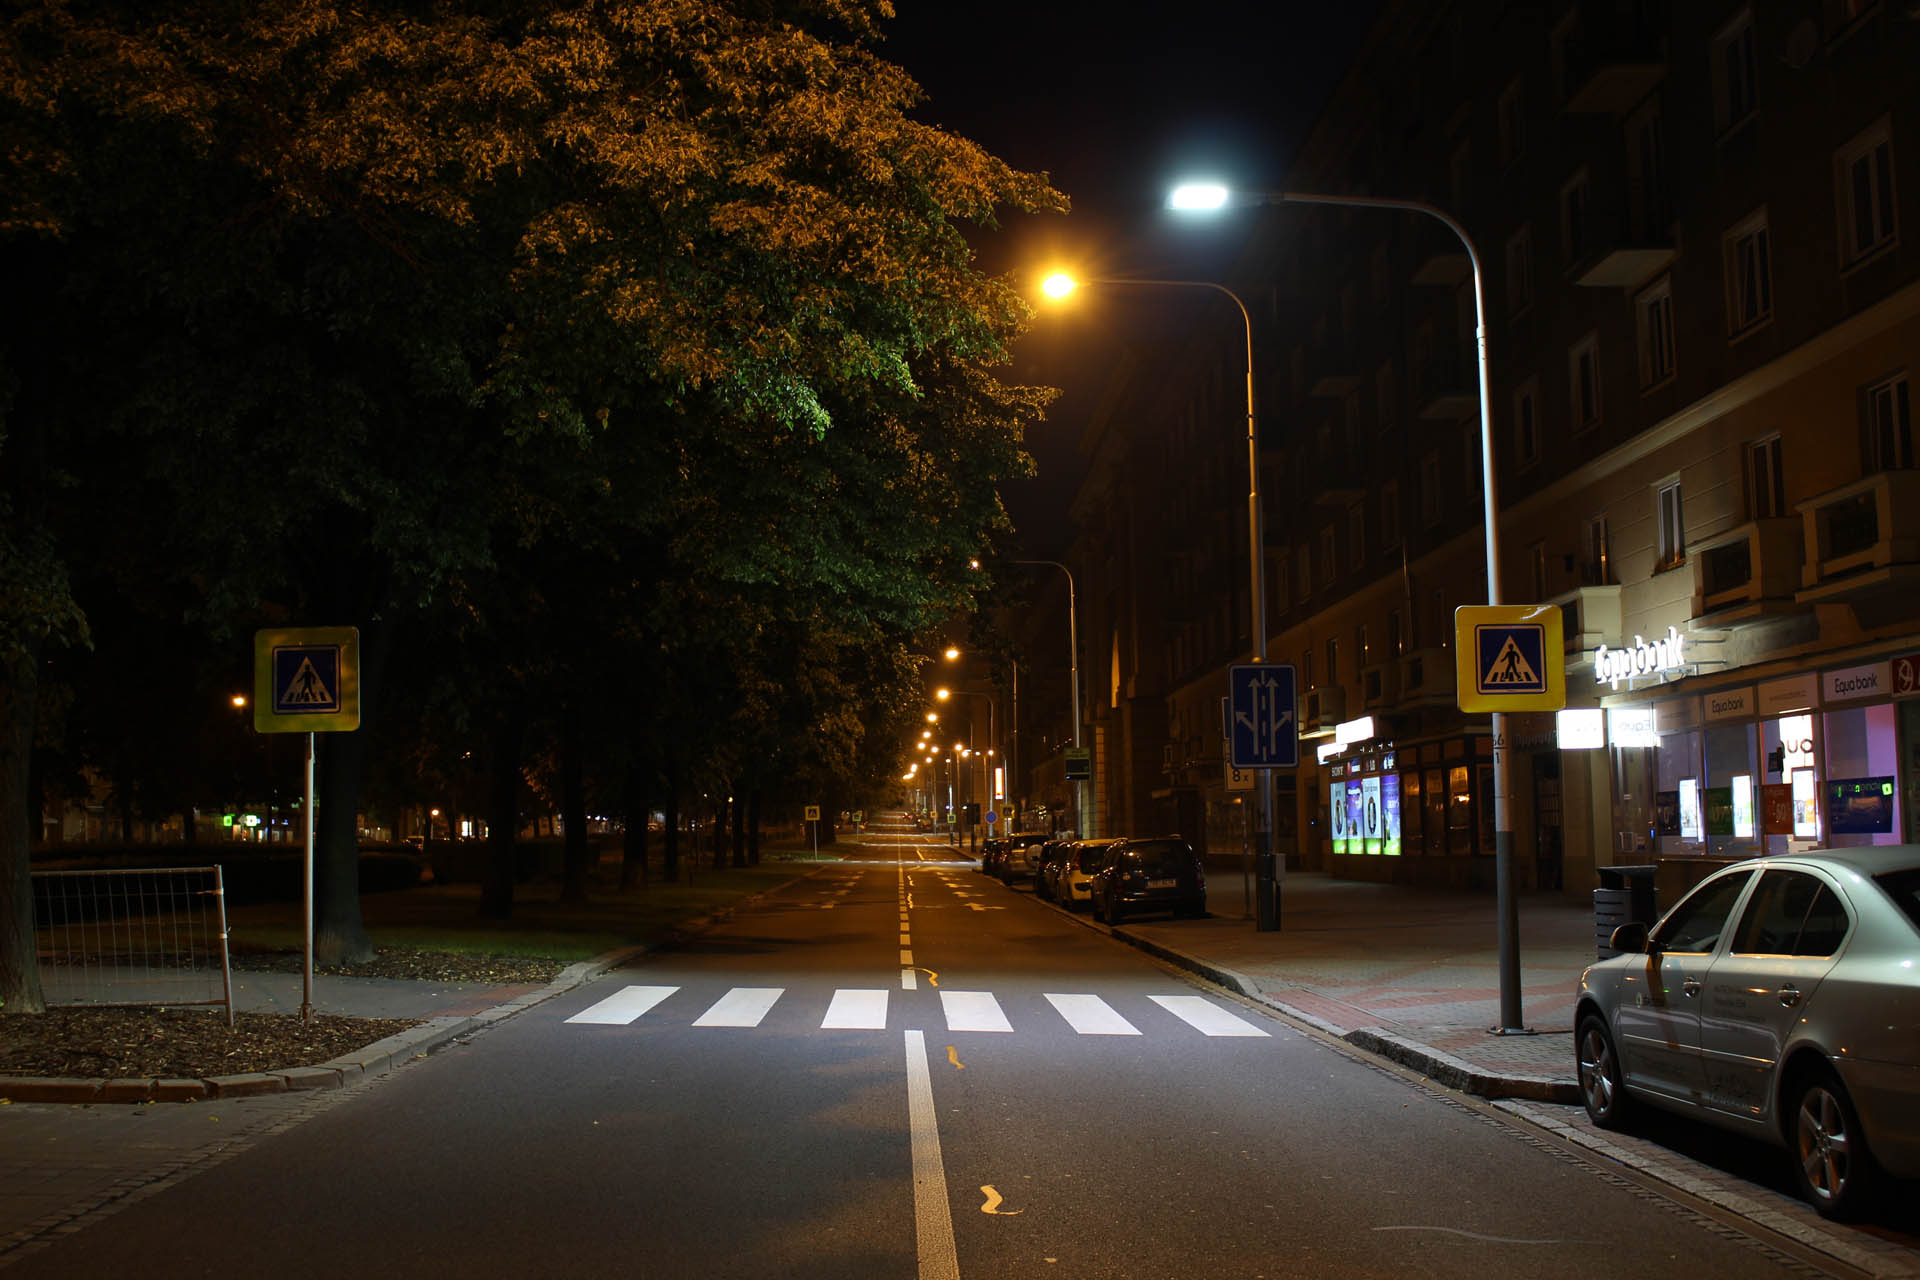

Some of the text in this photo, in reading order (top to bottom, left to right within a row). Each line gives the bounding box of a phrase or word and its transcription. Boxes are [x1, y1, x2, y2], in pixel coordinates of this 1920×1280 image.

[1834, 673, 1878, 695] Equa bank
[1712, 695, 1744, 715] Equa bank
